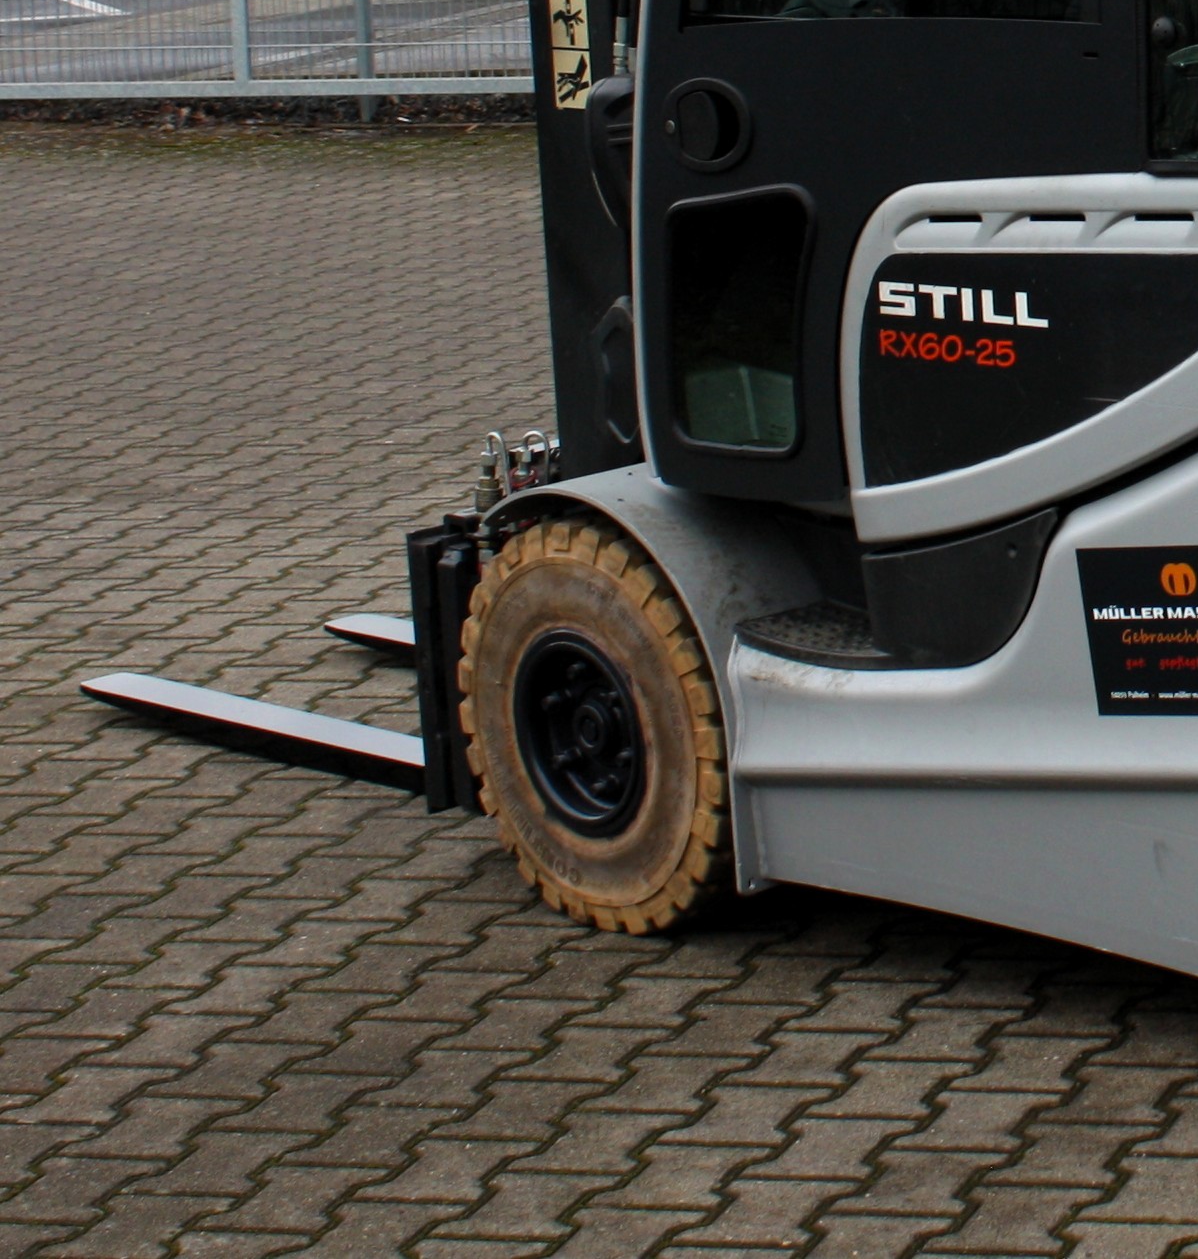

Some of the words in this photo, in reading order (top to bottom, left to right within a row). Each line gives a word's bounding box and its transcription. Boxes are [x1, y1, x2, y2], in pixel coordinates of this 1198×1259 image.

[878, 280, 1049, 329] STILL
[878, 329, 1016, 368] RX60-25
[1092, 605, 1164, 620] MÜLLER
